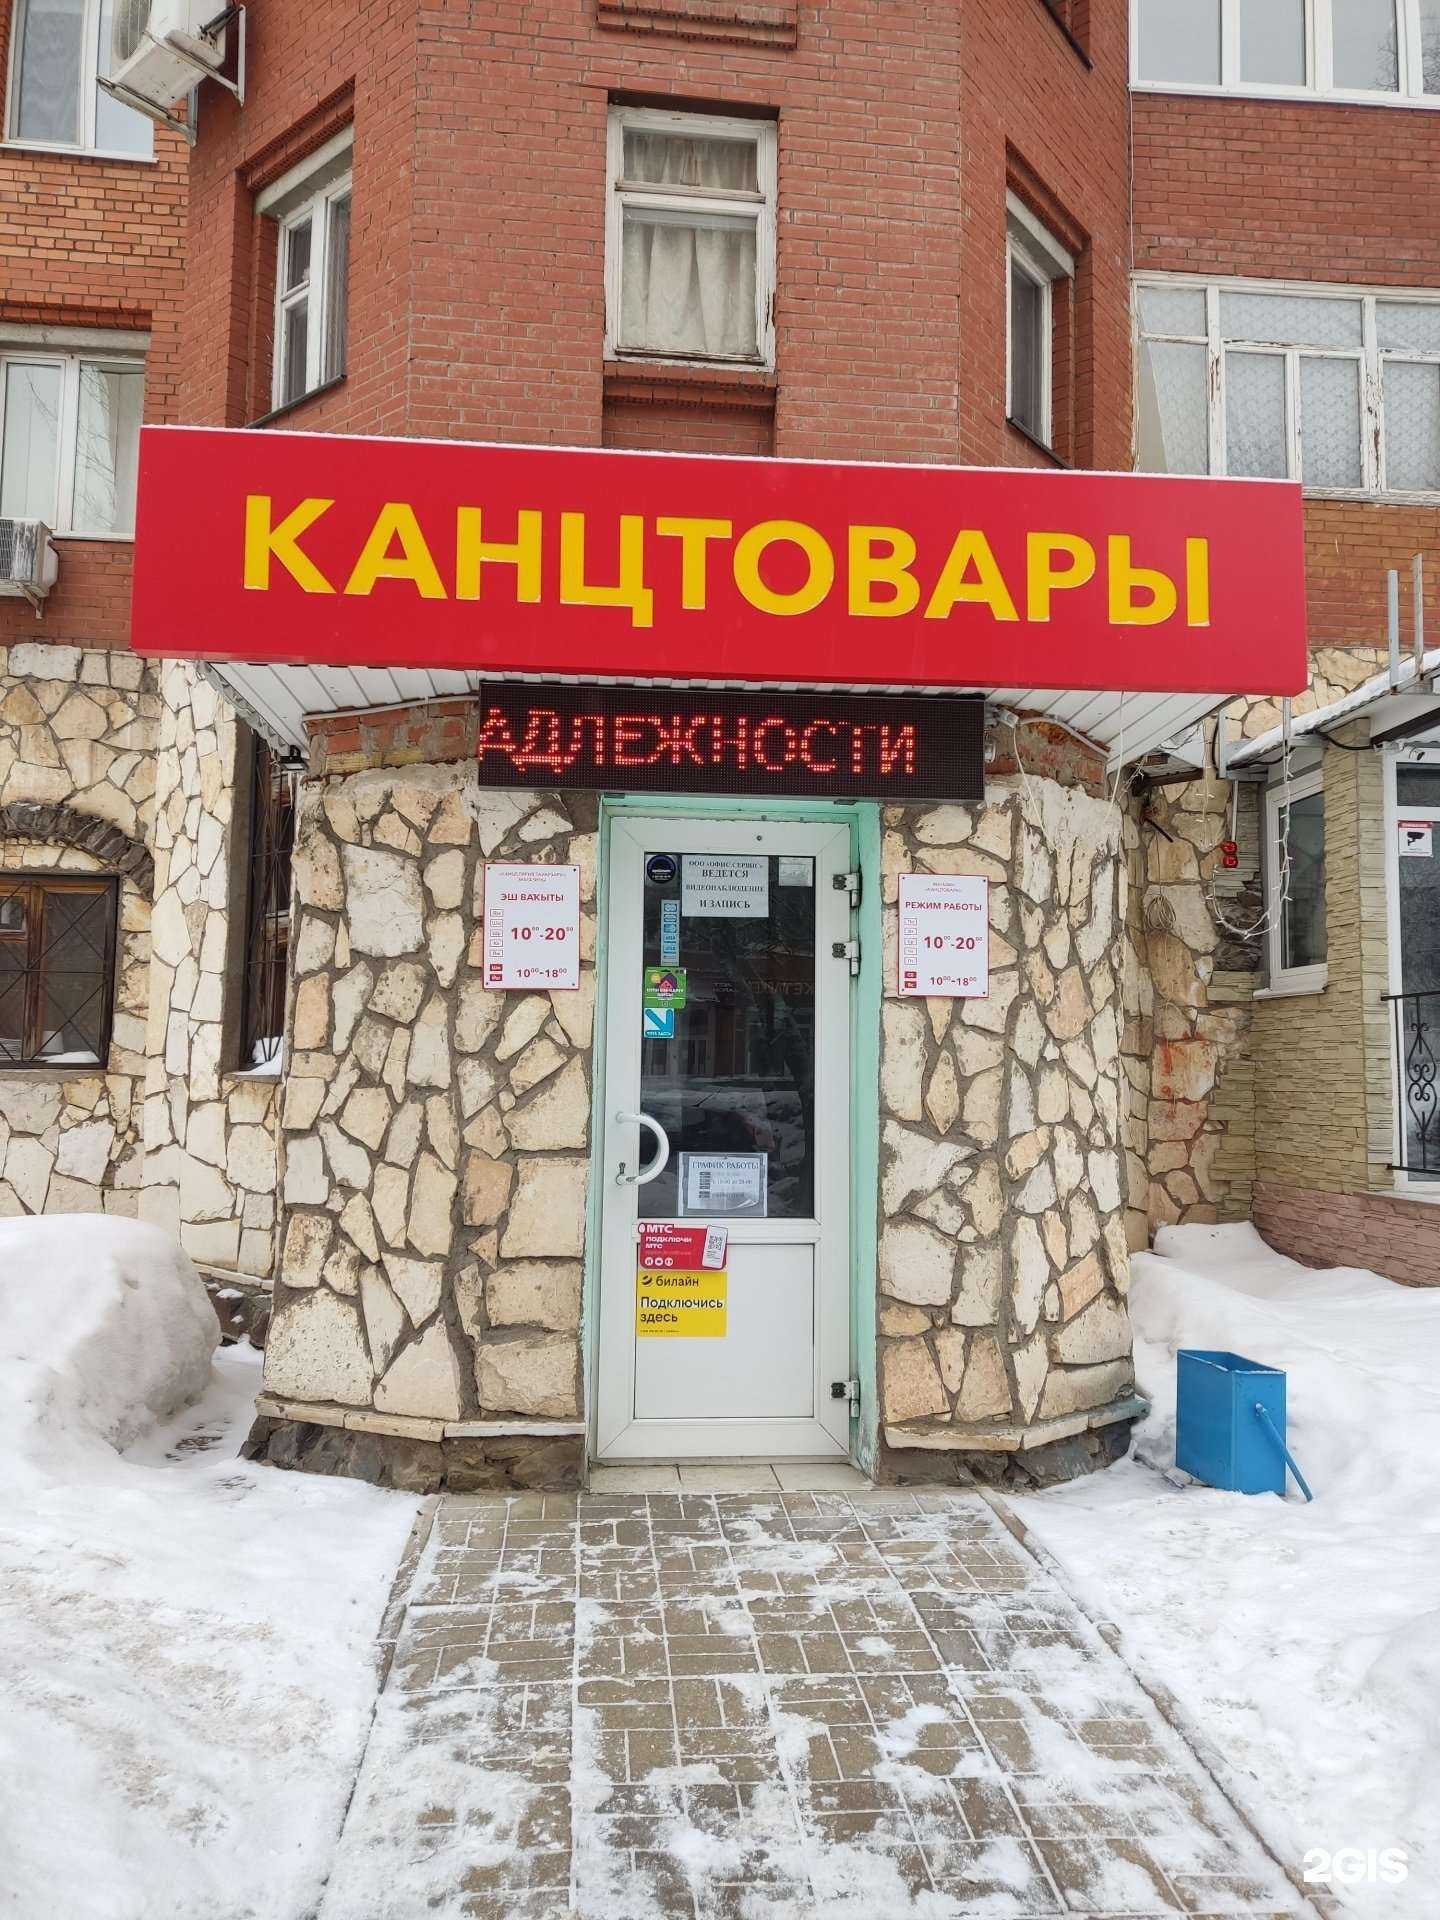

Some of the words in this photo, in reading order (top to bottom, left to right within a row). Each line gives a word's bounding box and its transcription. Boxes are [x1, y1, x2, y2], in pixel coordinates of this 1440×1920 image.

[243, 494, 1210, 629] КАНЦТОВАРЫ
[479, 707, 916, 773] АДЛЕЖНОСТИ
[702, 869, 749, 878] ВЕДЕТСЯ
[500, 893, 518, 901] ЭШ
[709, 899, 750, 909] ЗАПИСЬ
[905, 901, 941, 910] РЕЖИМ
[943, 902, 982, 911] РАБОТЫ
[692, 1161, 725, 1169] ГРАФИК
[726, 1161, 760, 1170] РАБОТЫ
[646, 1224, 673, 1234] МТС
[656, 1275, 700, 1287] билайн
[640, 1296, 724, 1310] Подключись
[640, 1313, 678, 1324] здесь
